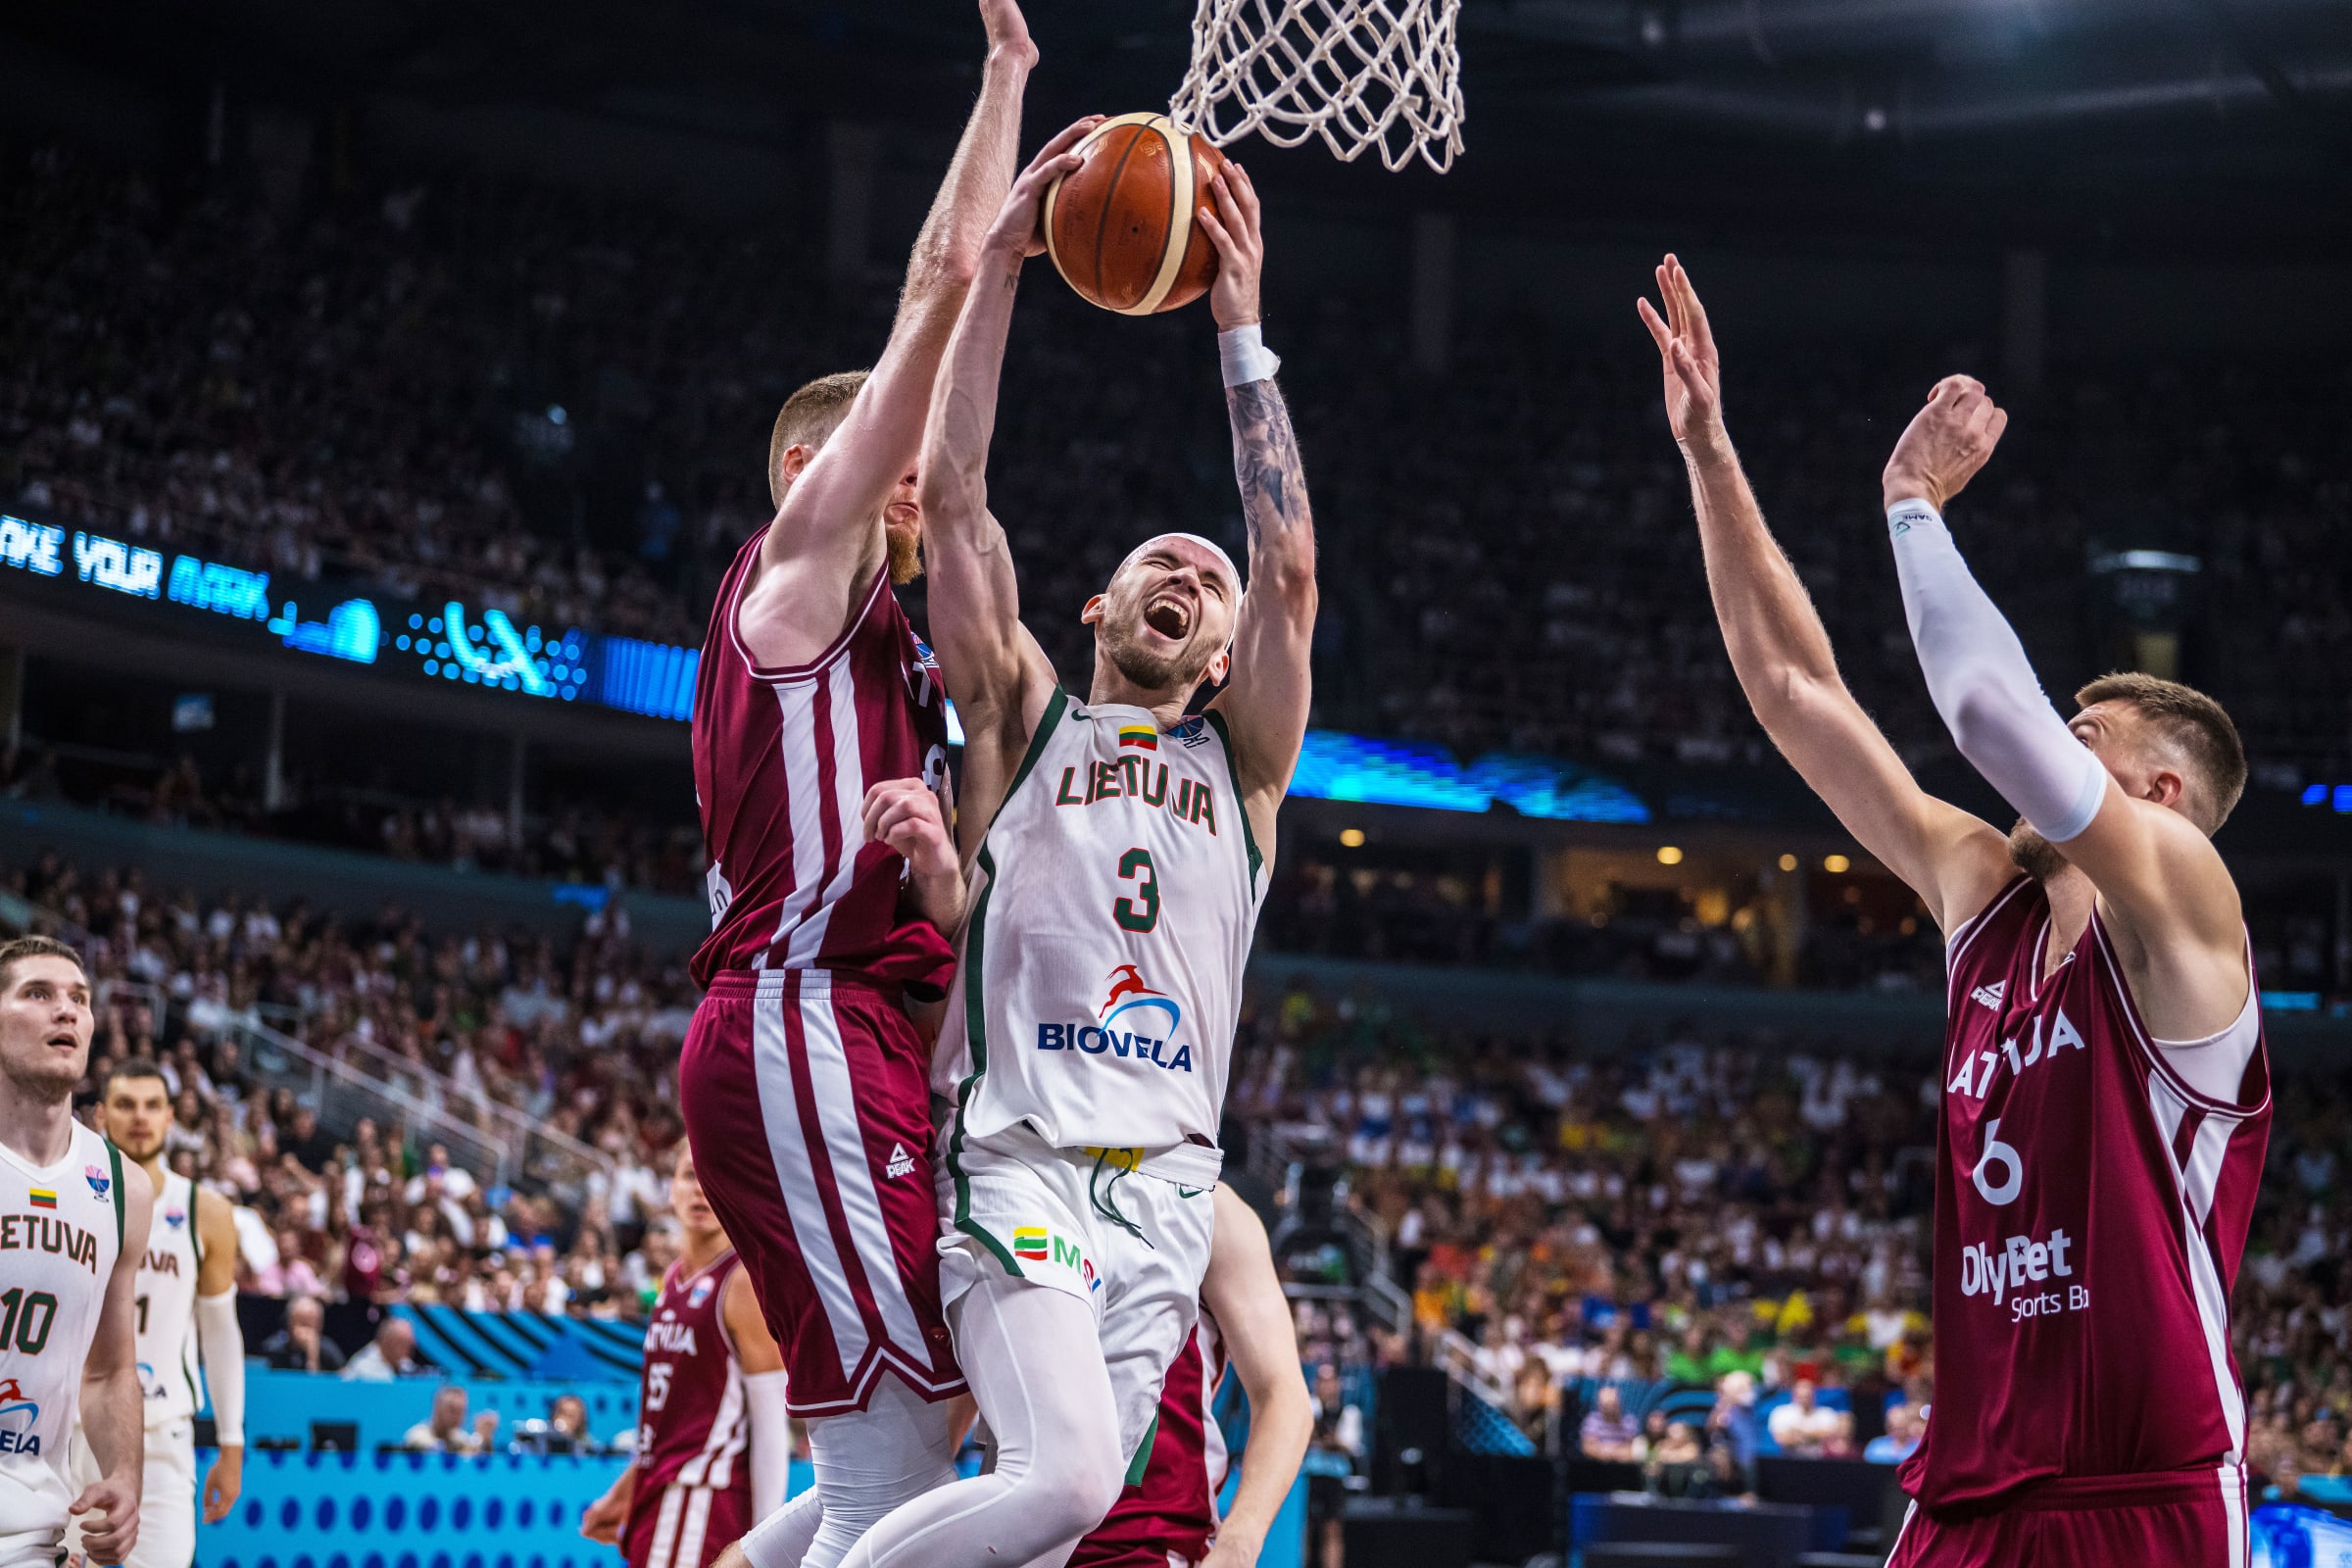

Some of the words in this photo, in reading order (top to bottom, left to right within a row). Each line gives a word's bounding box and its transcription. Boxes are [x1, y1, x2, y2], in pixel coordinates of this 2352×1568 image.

[74, 530, 163, 600] YOUR
[1112, 847, 1161, 934] 3
[1037, 1022, 1193, 1073] BIOVELA
[1972, 1117, 2023, 1206] 6
[0, 1214, 98, 1276] ETUVA
[0, 1287, 59, 1356] 10
